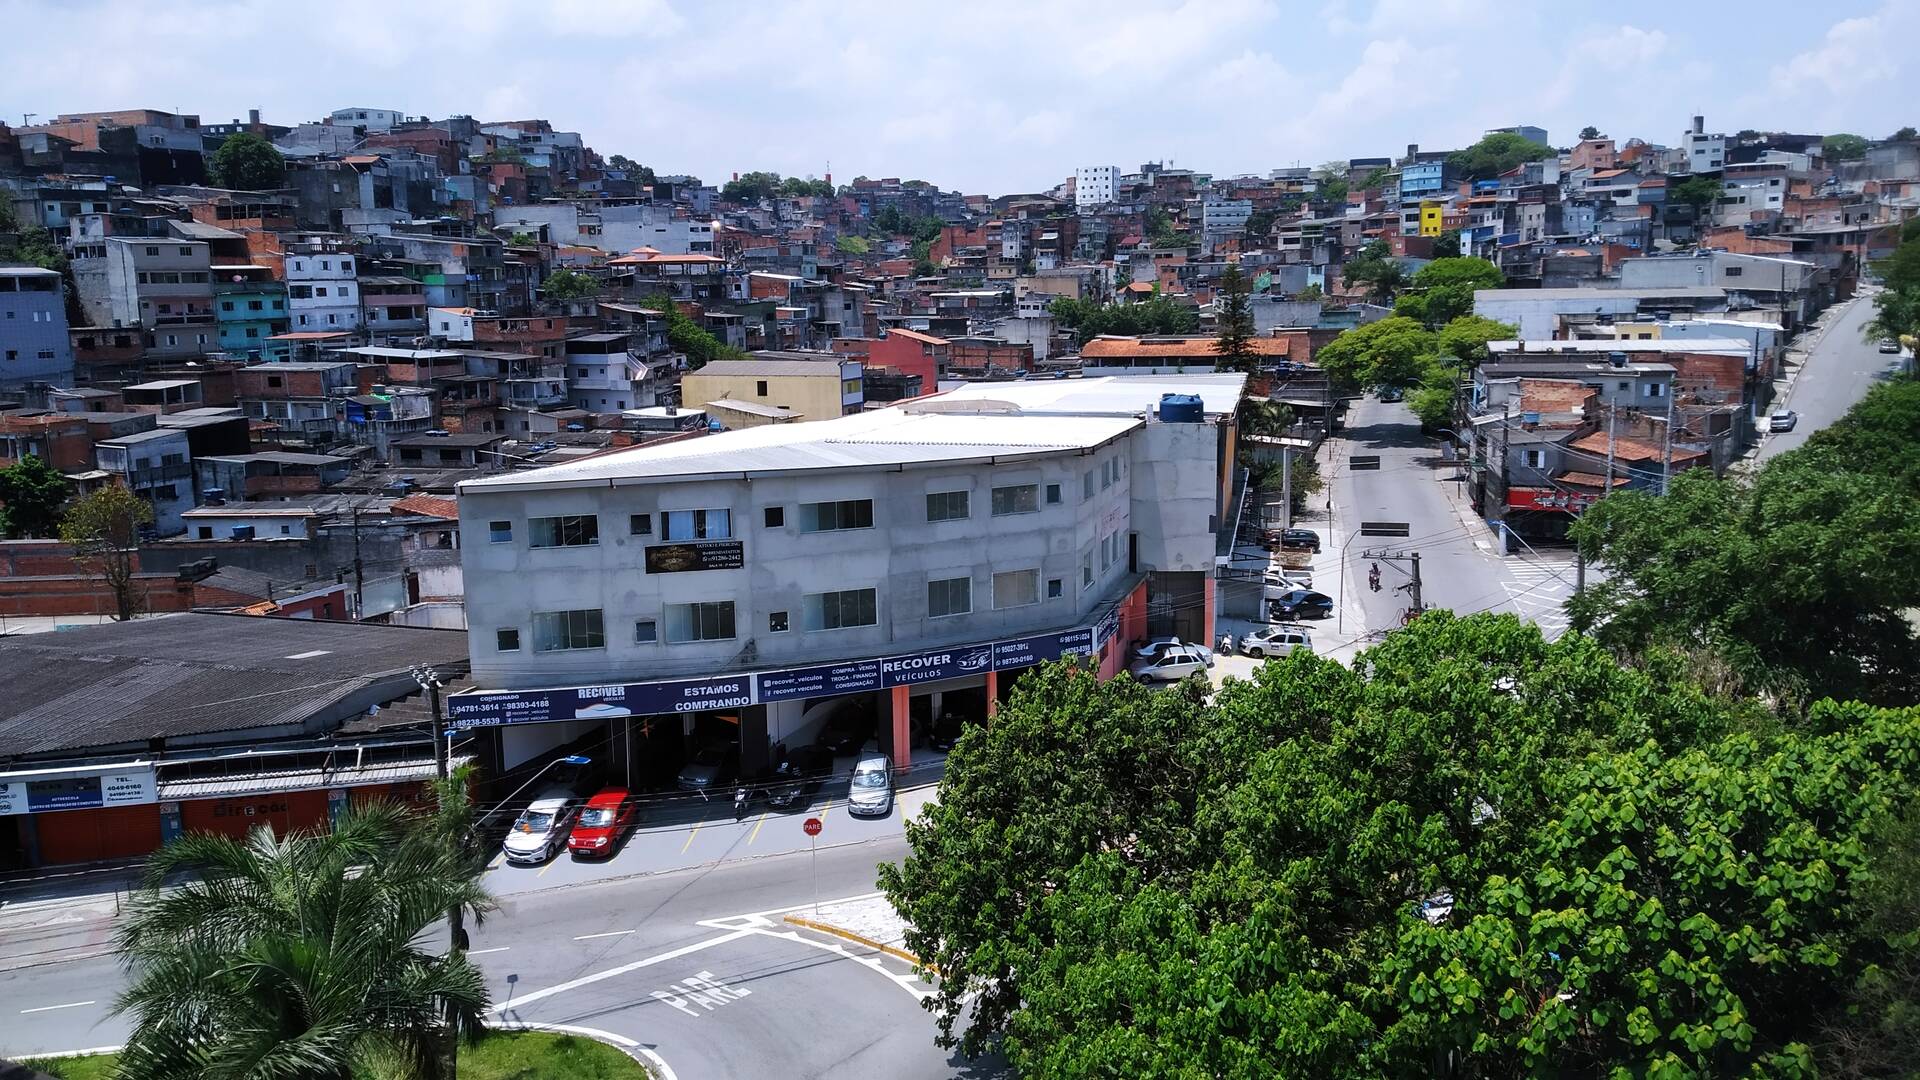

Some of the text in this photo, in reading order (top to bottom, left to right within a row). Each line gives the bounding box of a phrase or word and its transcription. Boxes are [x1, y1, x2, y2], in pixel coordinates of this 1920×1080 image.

[883, 654, 951, 673] RECOVER
[895, 669, 942, 682] VEÍCULOS
[577, 686, 625, 699] RECOVER
[684, 683, 739, 697] ESTAMOS
[674, 697, 749, 711] COMPRANDO
[649, 970, 753, 1017] PARE
